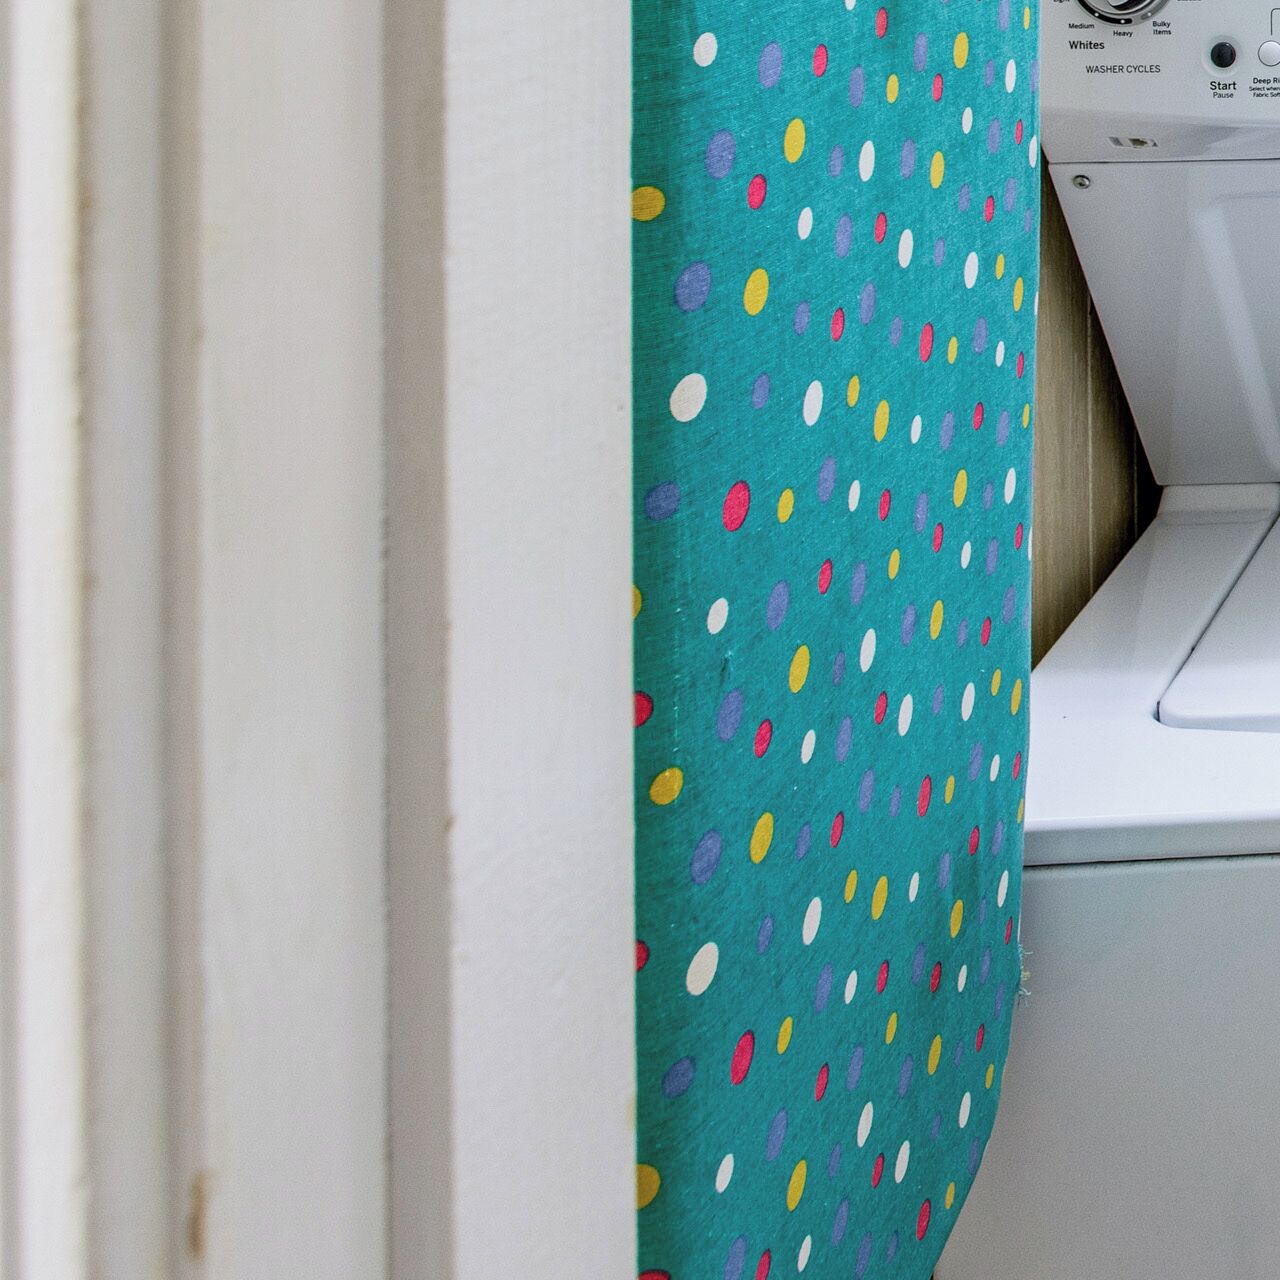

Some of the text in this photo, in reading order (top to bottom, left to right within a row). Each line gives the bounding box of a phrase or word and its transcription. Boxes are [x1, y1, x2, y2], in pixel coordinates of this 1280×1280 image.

[1069, 40, 1105, 49] Whites
[1086, 65, 1161, 73] WASHER CYCLES
[1253, 77, 1272, 85] Deep
[1210, 81, 1237, 90] Start
